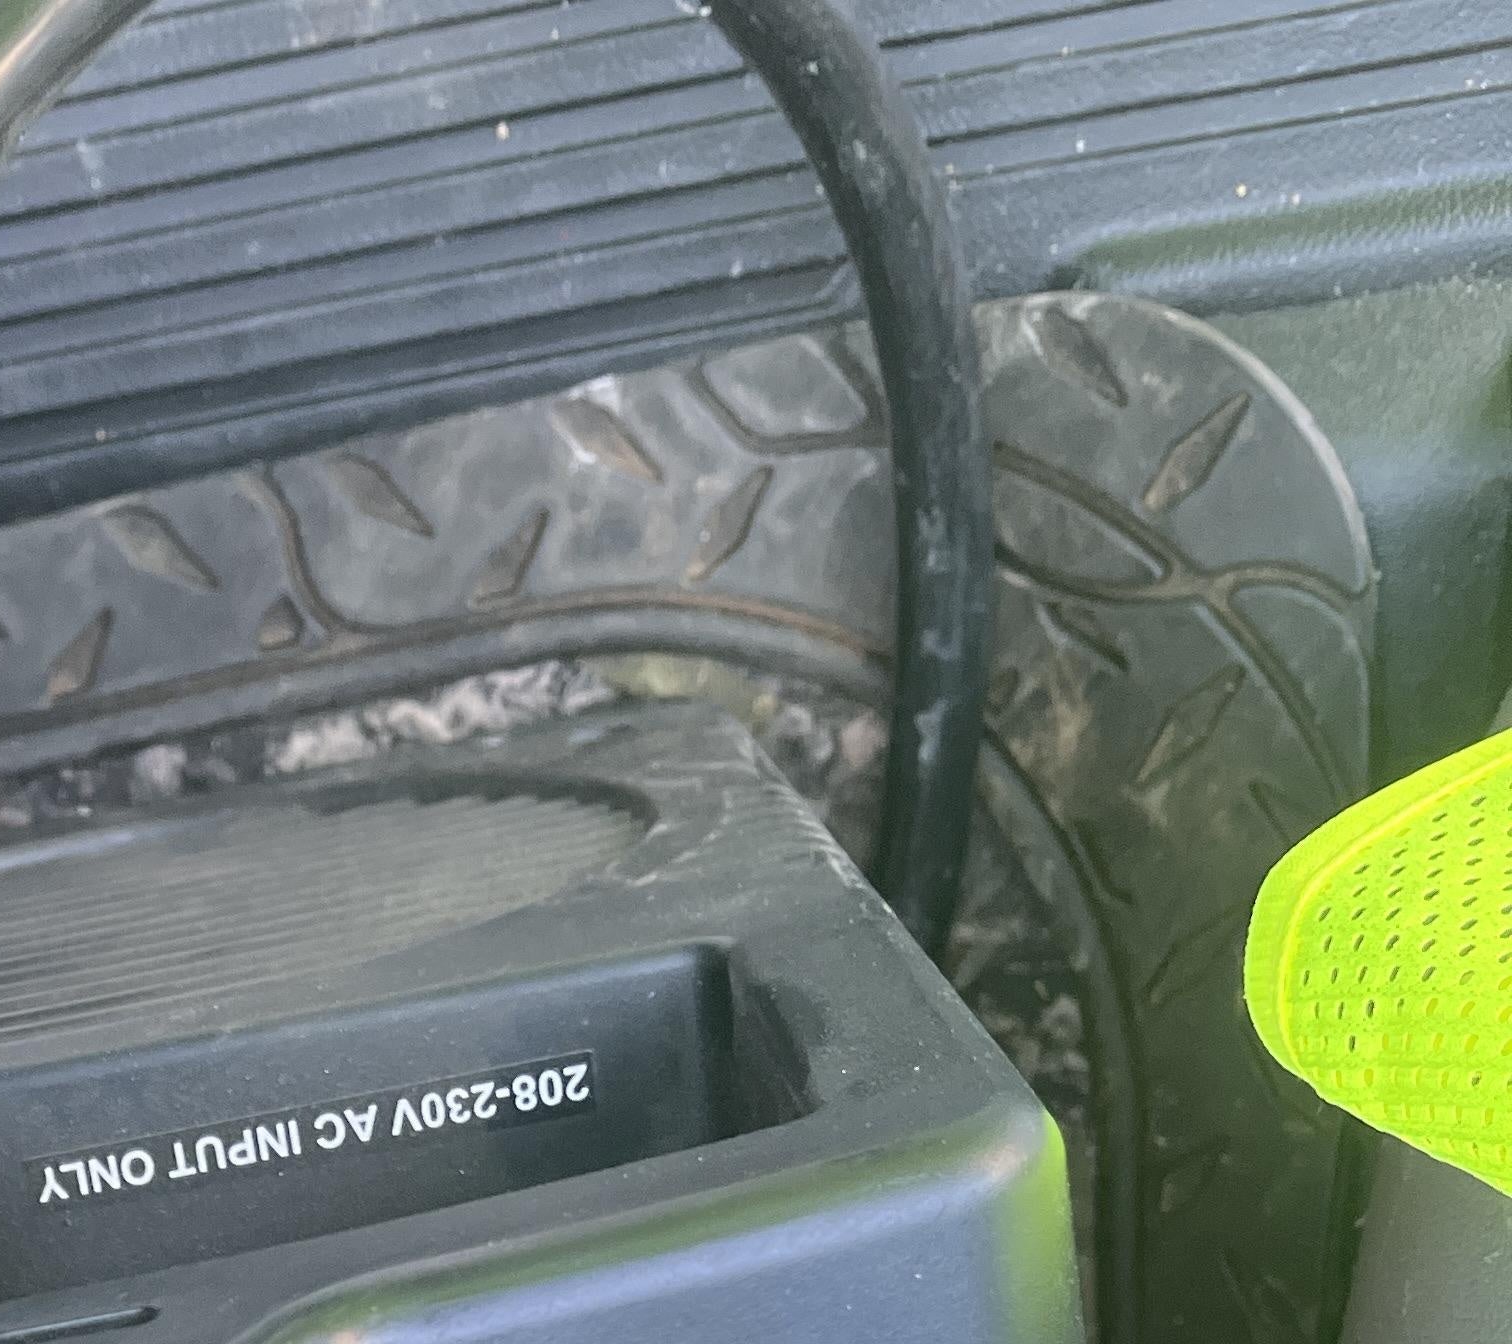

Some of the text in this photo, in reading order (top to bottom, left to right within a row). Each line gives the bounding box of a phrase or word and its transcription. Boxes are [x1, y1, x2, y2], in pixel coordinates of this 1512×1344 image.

[38, 1063, 590, 1203] 208-230V AC INPUT ONLY
